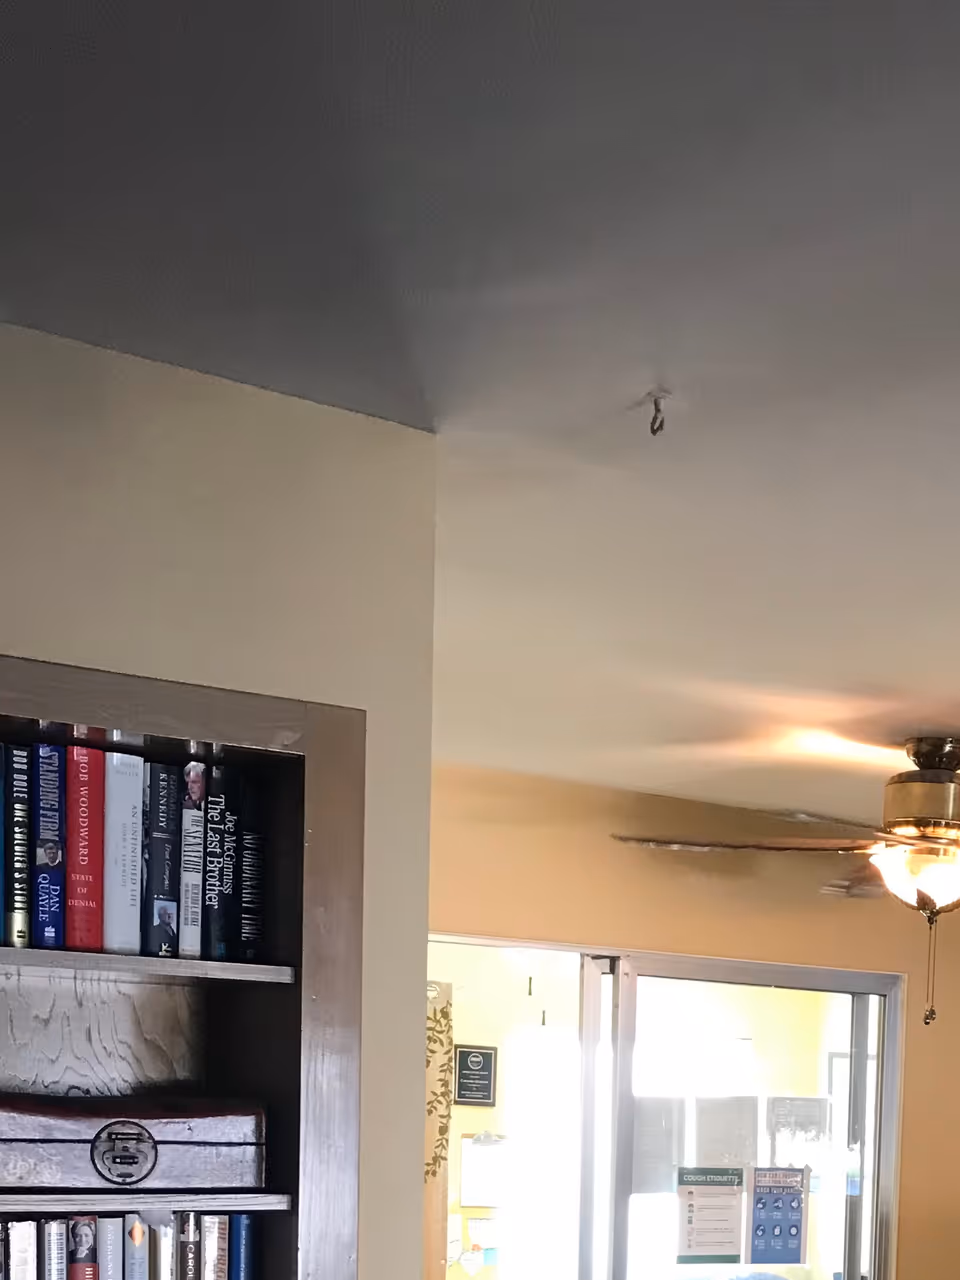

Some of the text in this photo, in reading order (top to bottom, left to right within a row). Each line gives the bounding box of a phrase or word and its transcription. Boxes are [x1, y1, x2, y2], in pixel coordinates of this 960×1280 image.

[13, 773, 28, 798] DOLE
[39, 745, 59, 841] STANDING FIRM
[79, 755, 88, 865] BOB WOODWARD
[131, 804, 138, 817] AN
[158, 773, 167, 828] KENNEDY
[13, 803, 28, 822] ONE
[183, 815, 204, 874] THE SENATOR
[205, 794, 226, 910] The Last Brother
[223, 811, 238, 894] Joe McGinniss
[38, 873, 49, 921] QUAYLE
[50, 885, 60, 912] DAN
[68, 899, 97, 908] DENIAL
[241, 831, 263, 941] NO ORDINARY TIME
[186, 1244, 195, 1280] CAROL
